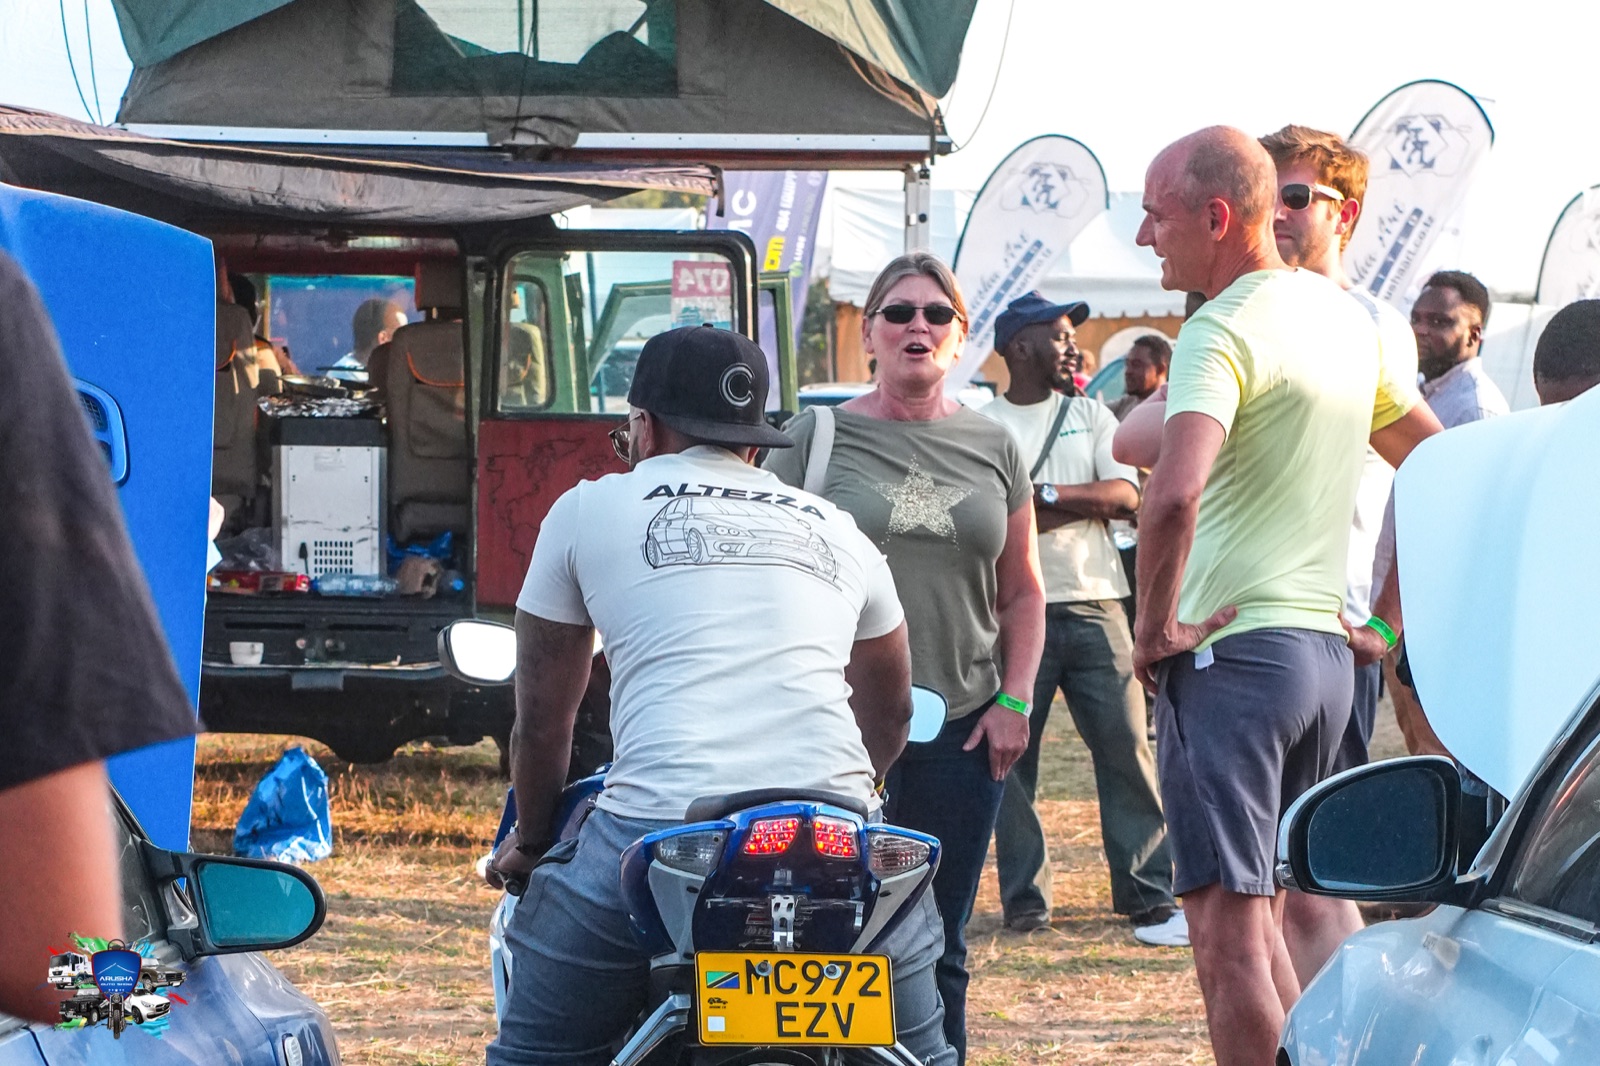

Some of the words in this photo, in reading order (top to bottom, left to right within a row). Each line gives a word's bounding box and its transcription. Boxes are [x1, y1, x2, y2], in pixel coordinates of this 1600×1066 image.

[719, 362, 754, 407] C
[643, 483, 826, 521] ALTEZZA
[745, 959, 882, 998] MC972
[776, 1002, 855, 1038] EZV
